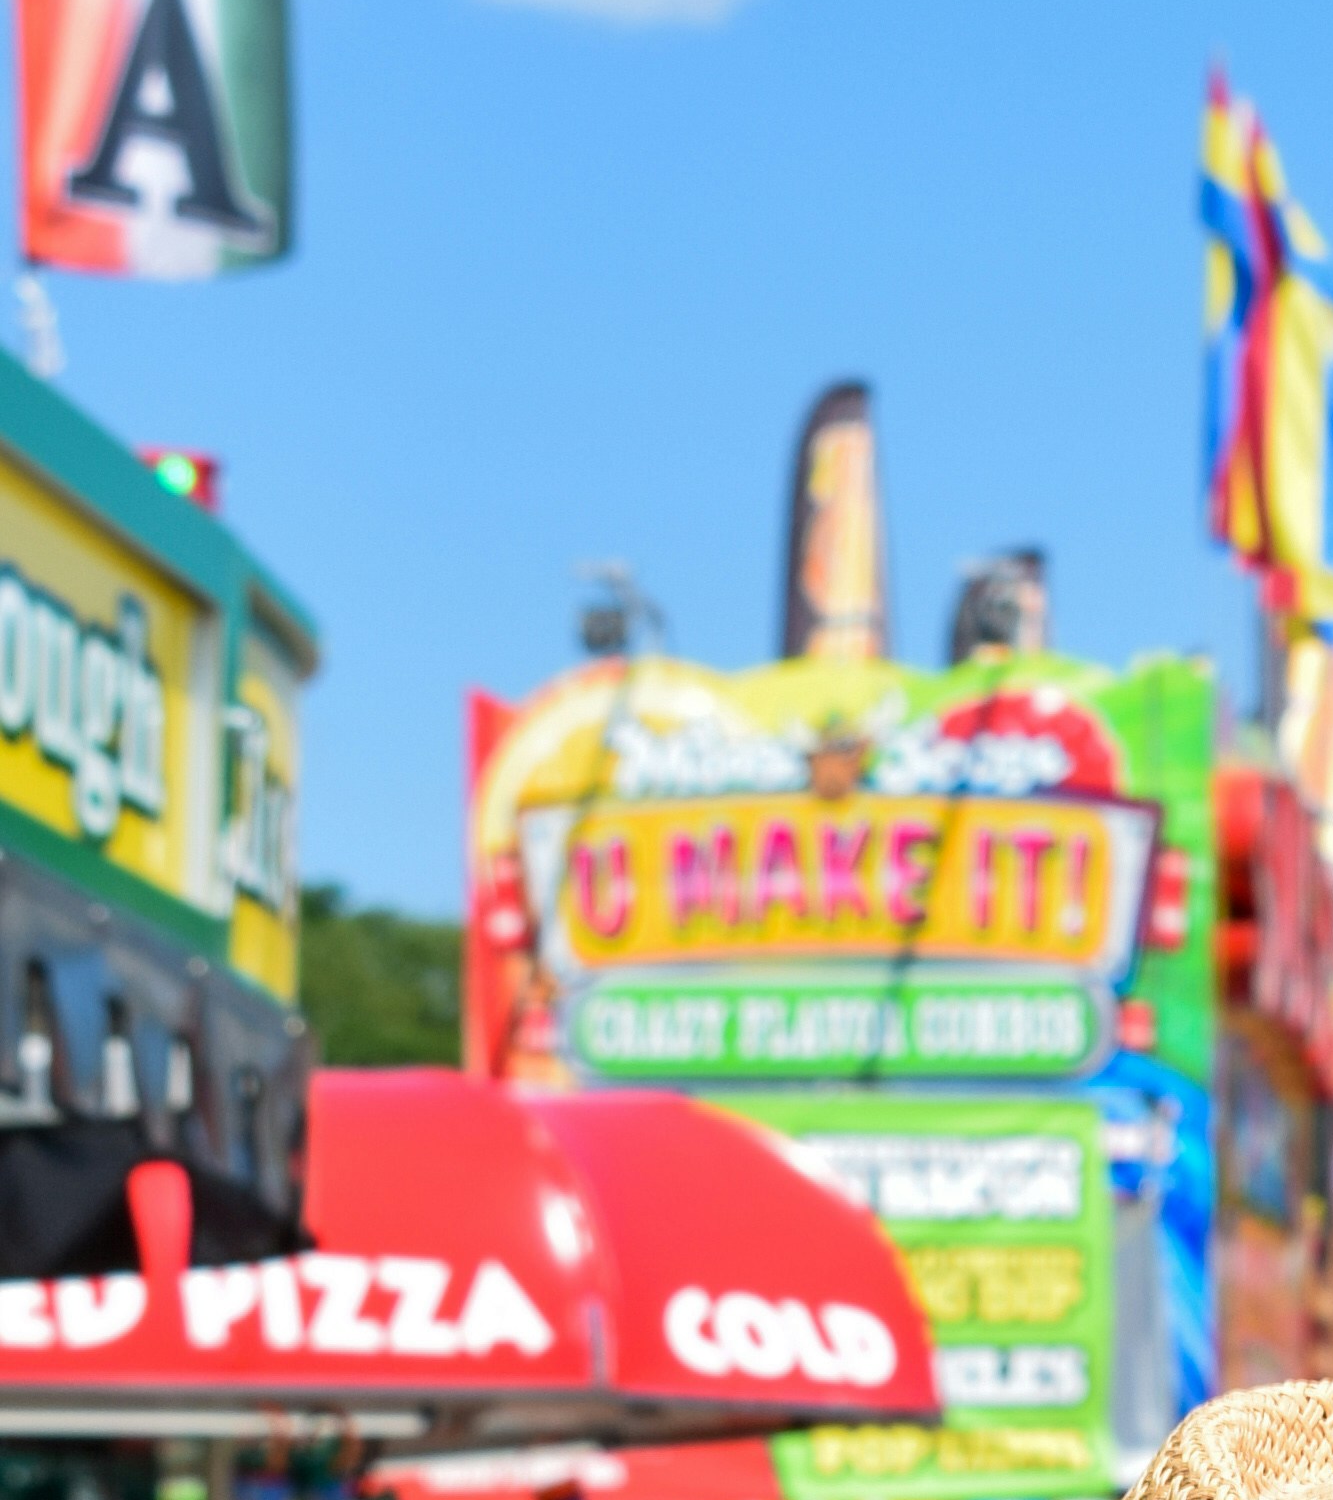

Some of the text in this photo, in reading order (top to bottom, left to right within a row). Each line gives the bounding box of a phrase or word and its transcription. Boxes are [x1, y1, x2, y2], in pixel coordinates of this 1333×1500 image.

[574, 820, 1092, 939] U MAKE IT!
[182, 1252, 555, 1357] PIZZA
[662, 1285, 900, 1388] COLD
